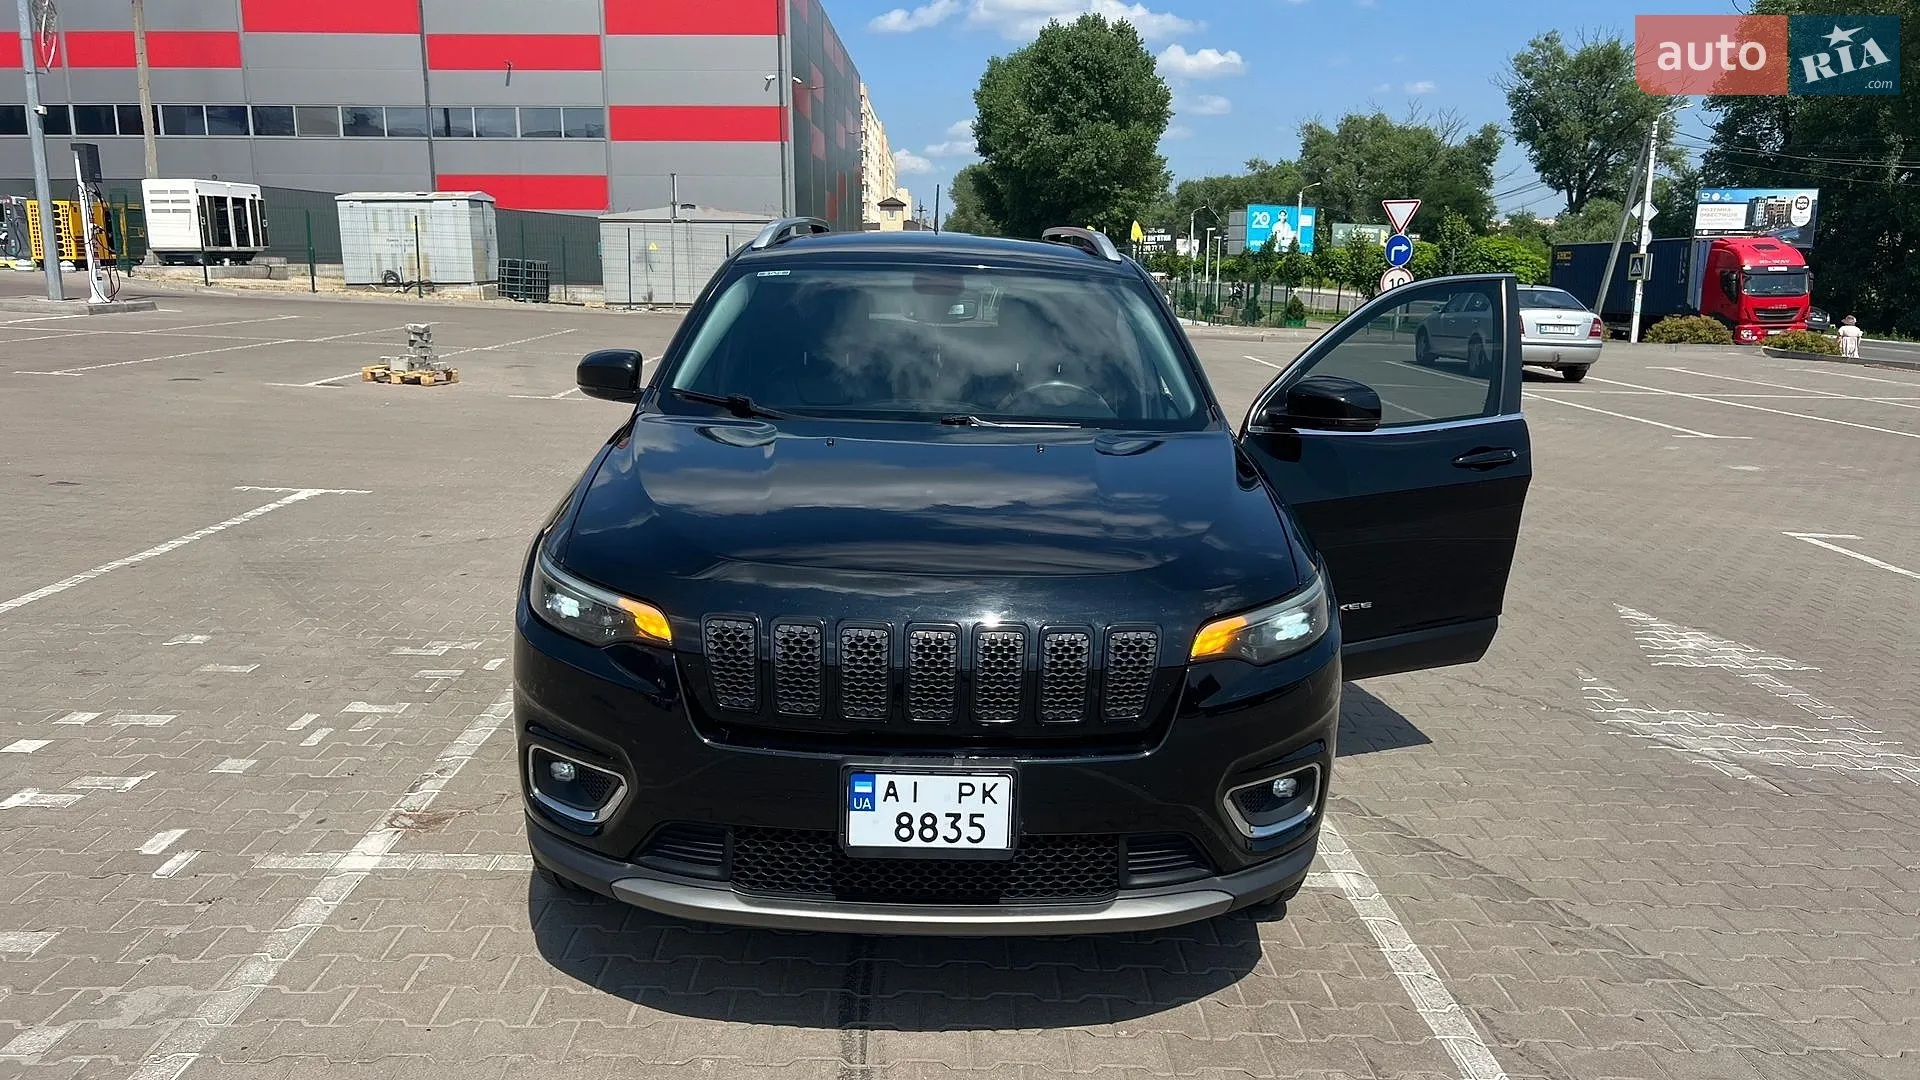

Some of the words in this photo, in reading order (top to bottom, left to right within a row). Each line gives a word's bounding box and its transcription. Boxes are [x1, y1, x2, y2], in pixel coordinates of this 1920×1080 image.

[853, 797, 872, 810] UA
[883, 780, 918, 803] AI
[958, 782, 999, 805] PK
[894, 811, 986, 844] 8835
